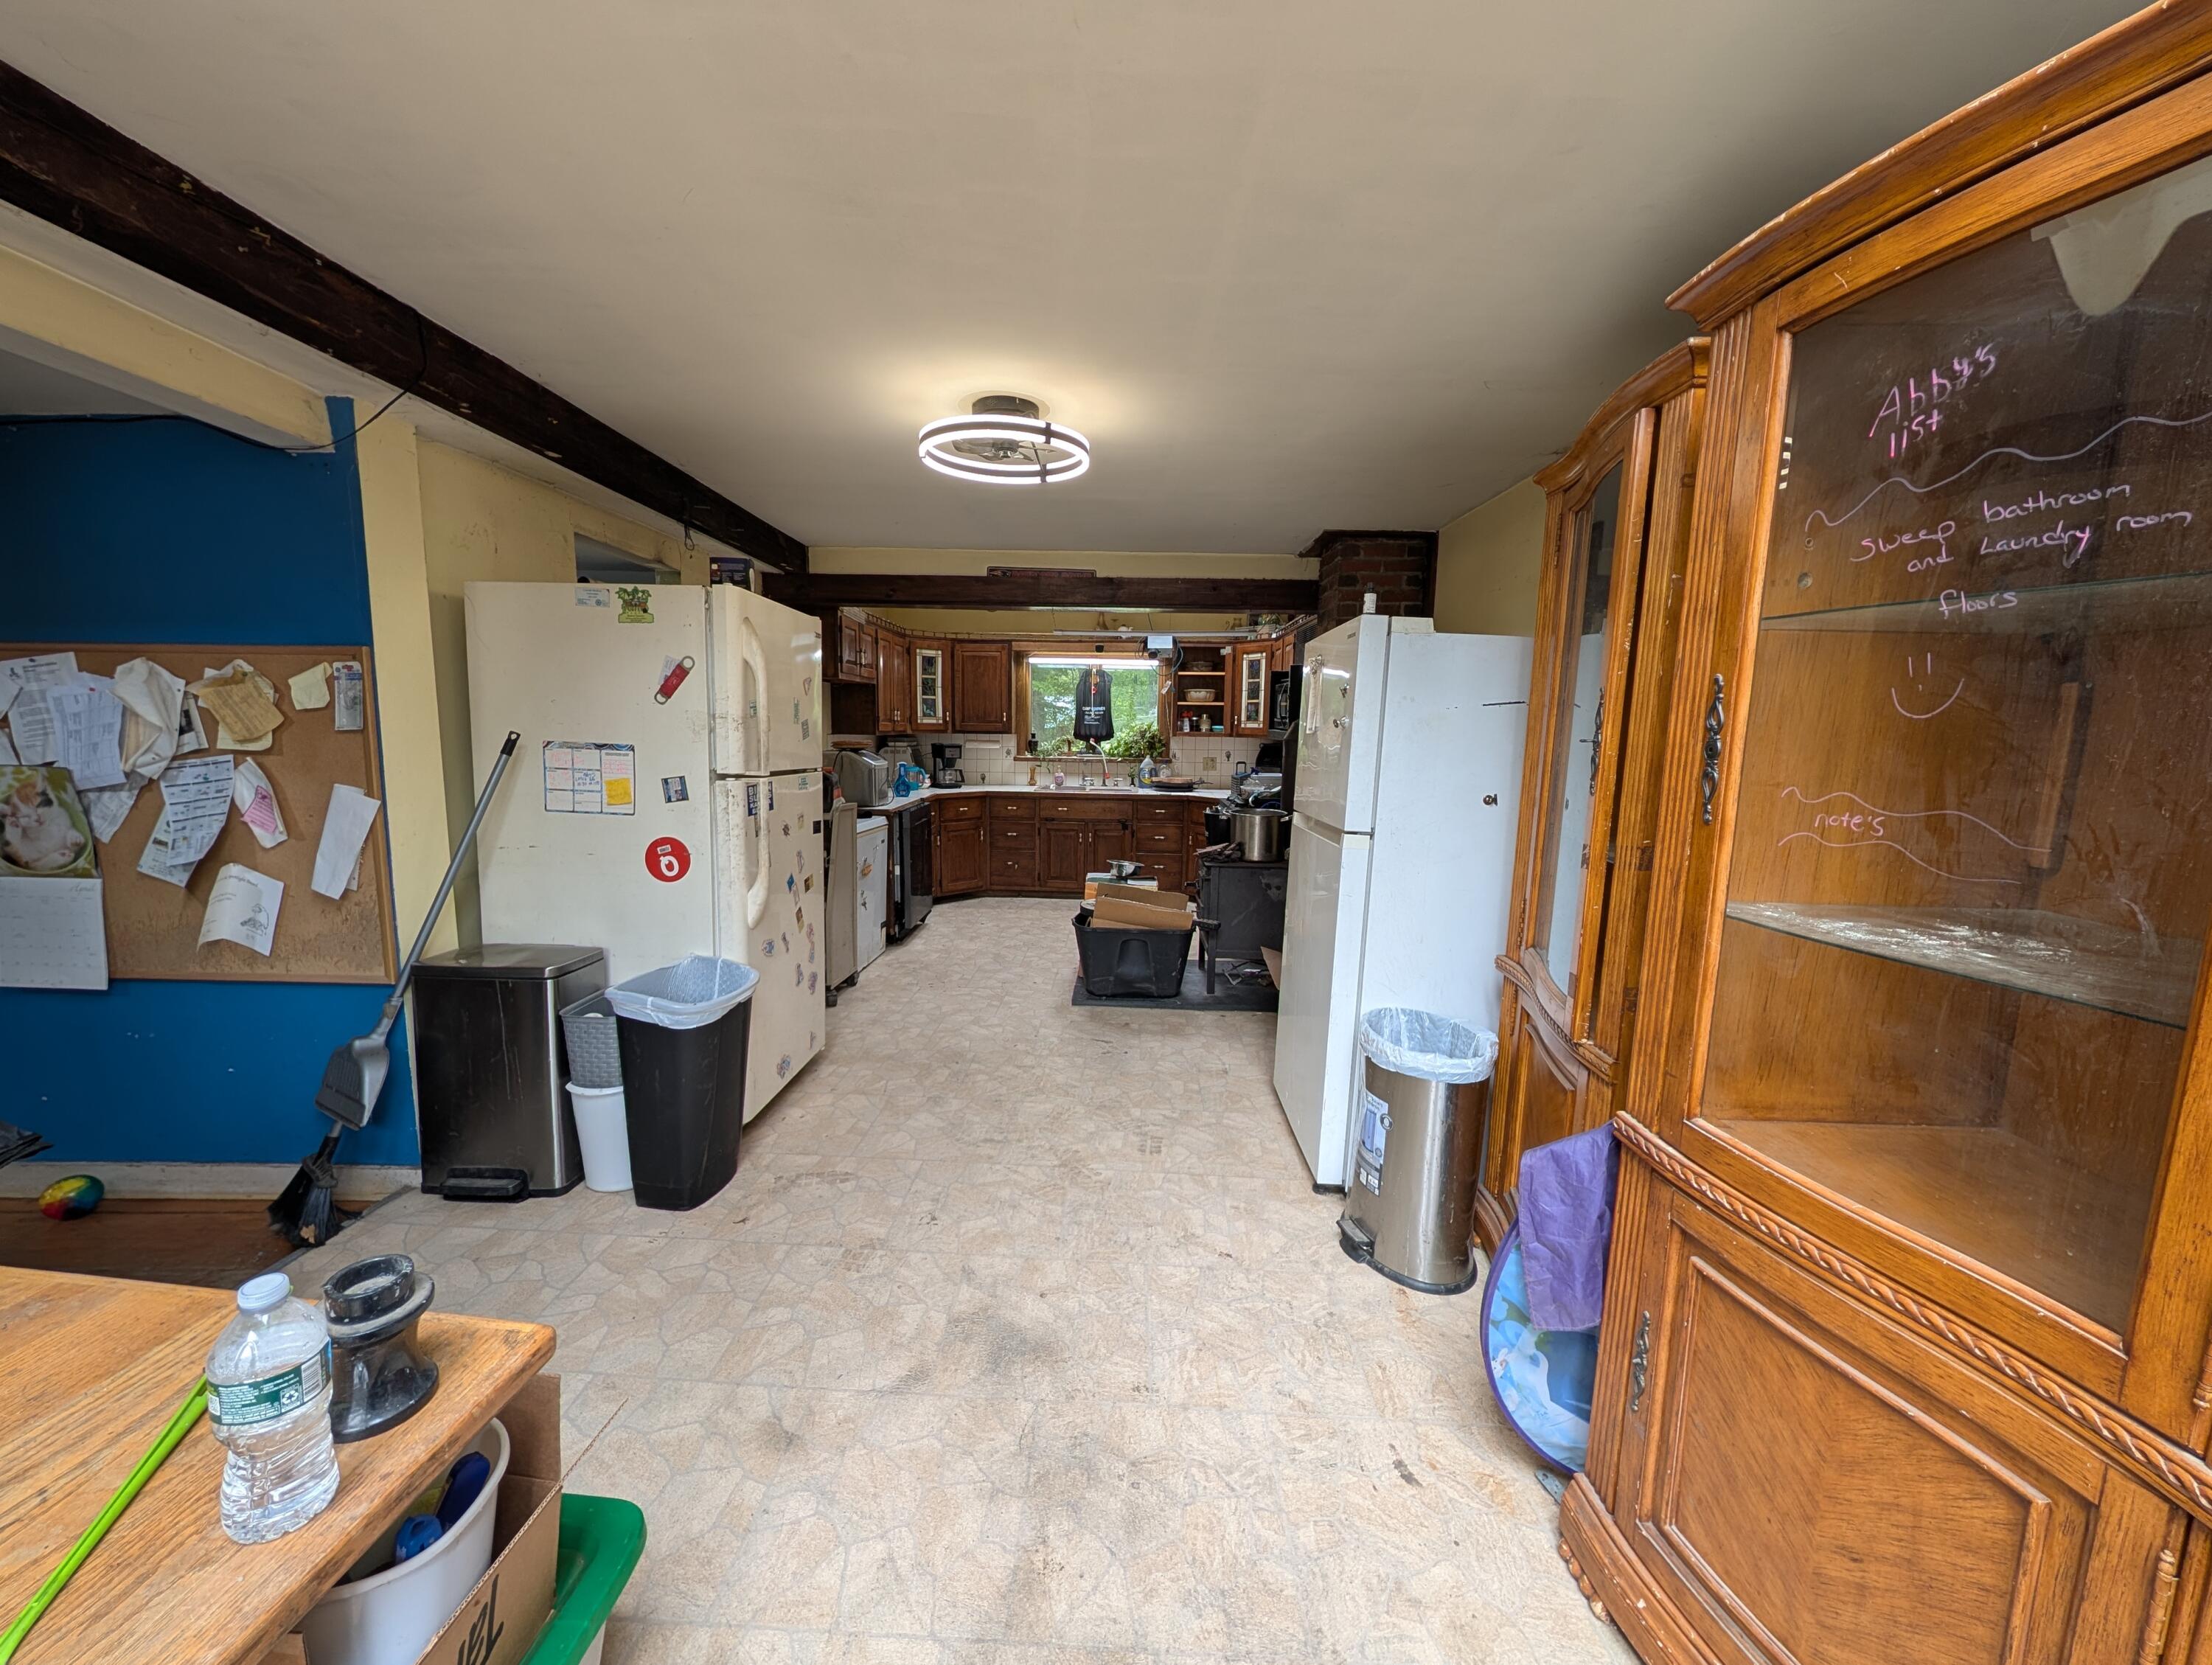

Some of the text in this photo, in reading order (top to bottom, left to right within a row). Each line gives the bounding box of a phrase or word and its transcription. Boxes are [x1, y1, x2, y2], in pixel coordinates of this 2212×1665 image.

[1983, 484, 2131, 524] bathroom
[1907, 545, 1954, 572] and
[2116, 510, 2193, 532] room
[1938, 590, 2019, 619] floors
[1814, 813, 1885, 836] note's
